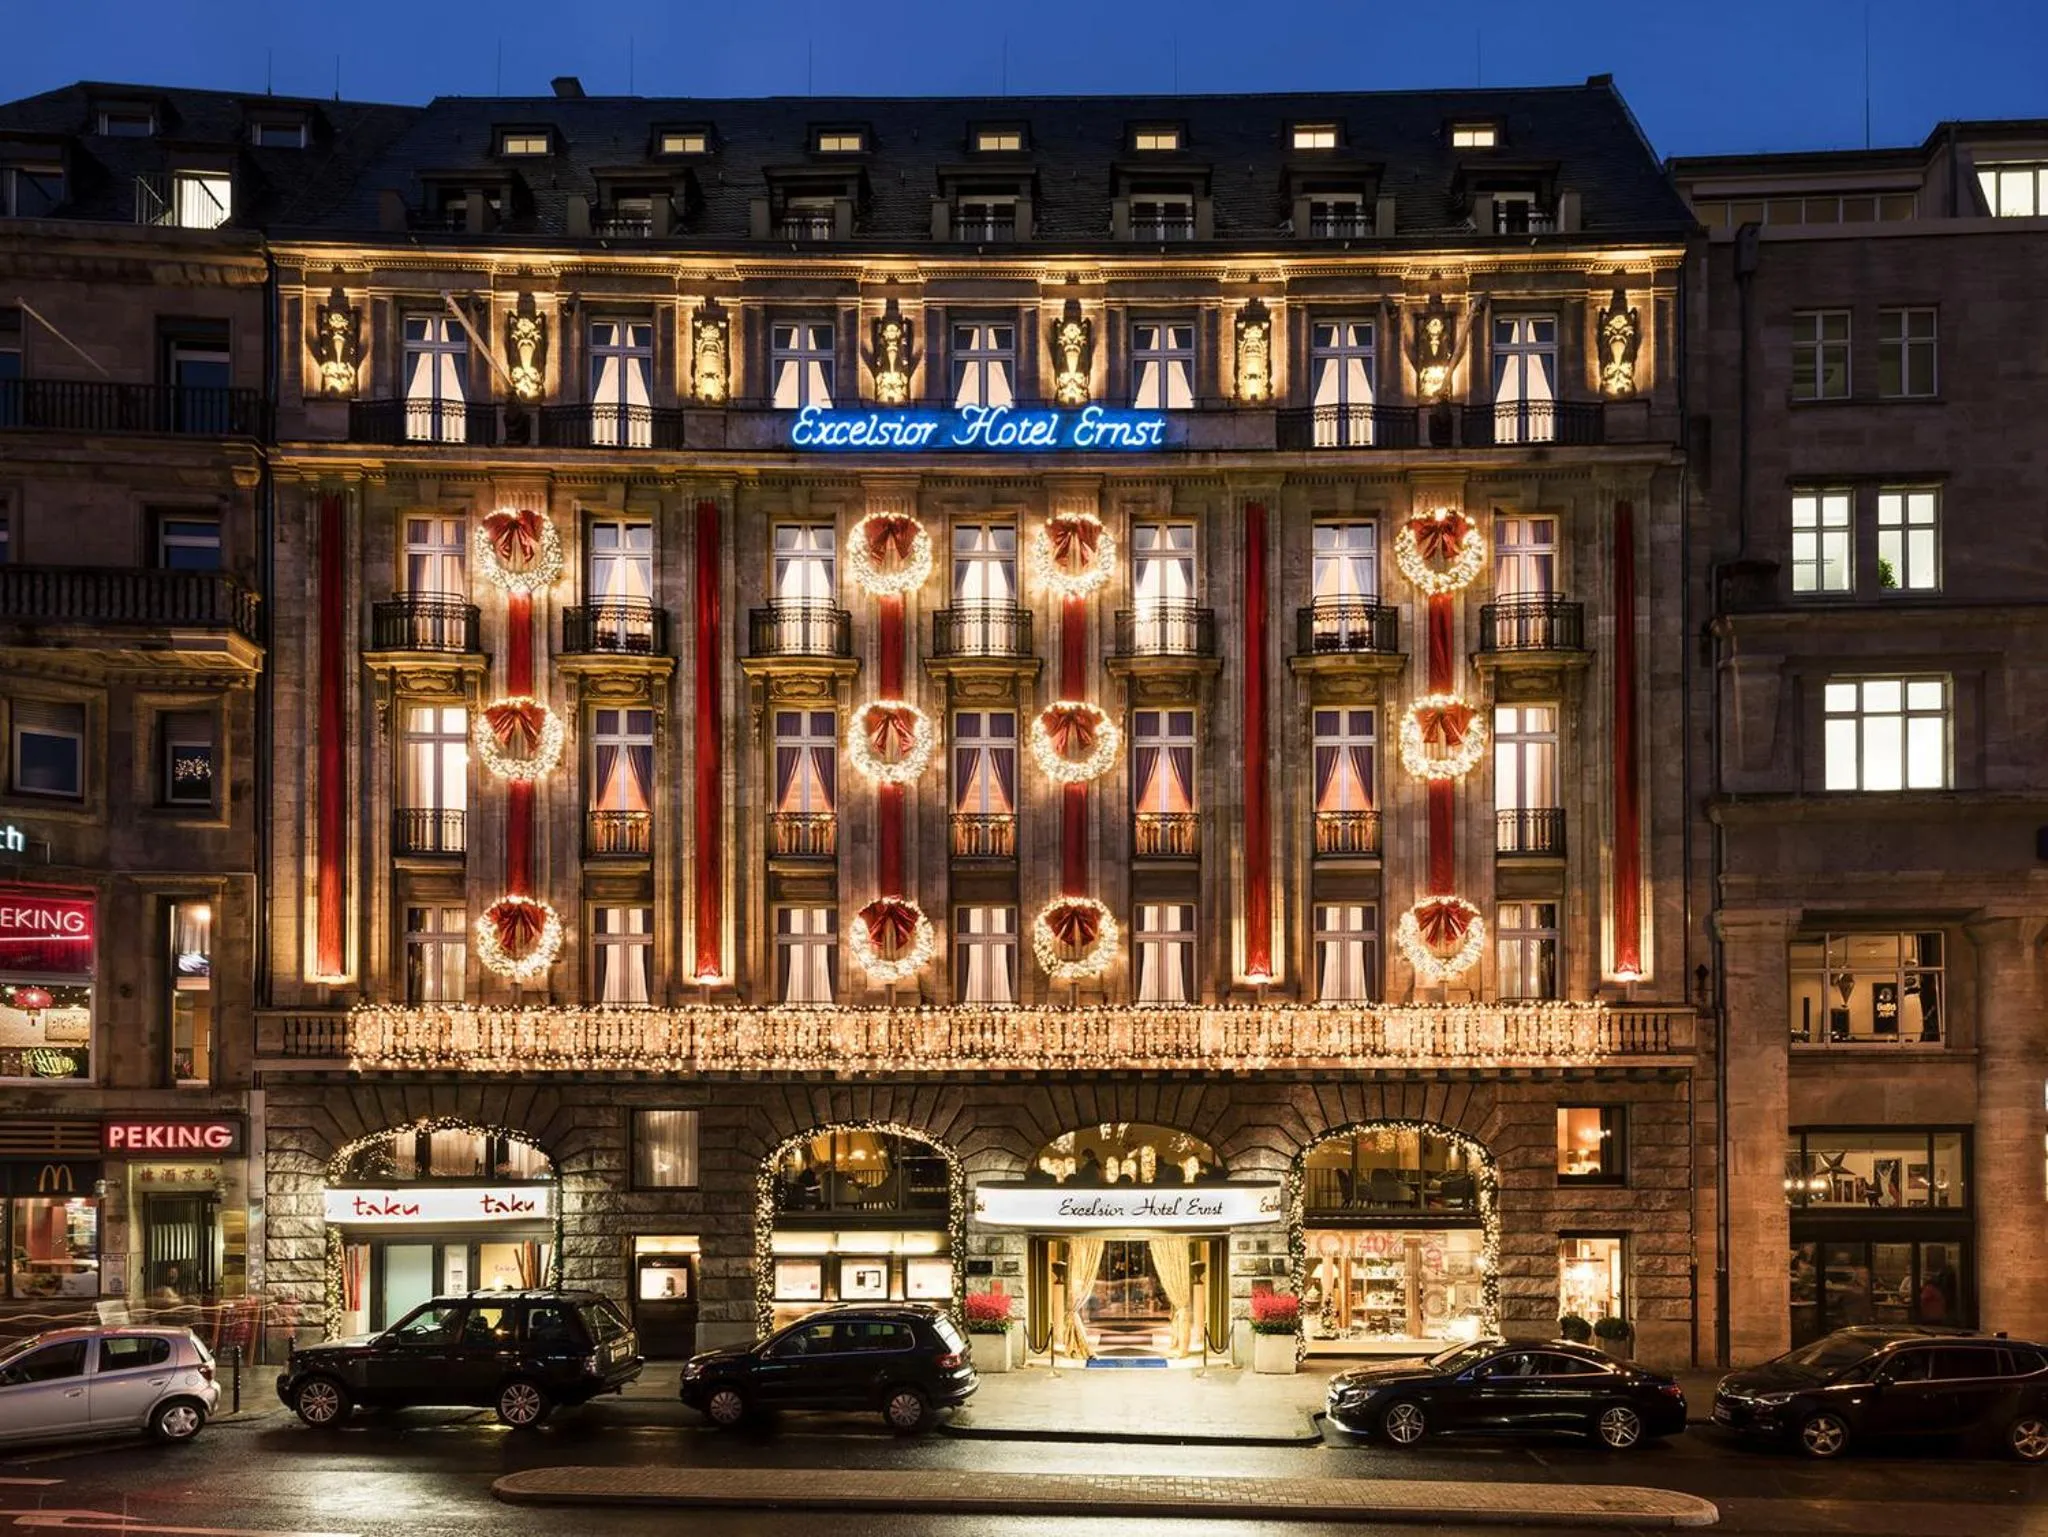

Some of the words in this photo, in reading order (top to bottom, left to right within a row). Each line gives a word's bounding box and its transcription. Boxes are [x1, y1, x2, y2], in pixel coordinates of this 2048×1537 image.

[792, 404, 938, 446] Excelsior
[952, 404, 1058, 446] Hotel
[1074, 405, 1167, 446] Ernst
[109, 1125, 233, 1148] PEKING
[353, 1196, 419, 1215] taku
[480, 1194, 535, 1214] taku
[1058, 1198, 1125, 1216] Excelsior
[1132, 1195, 1182, 1216] Hotel
[1186, 1198, 1223, 1216] Ernst
